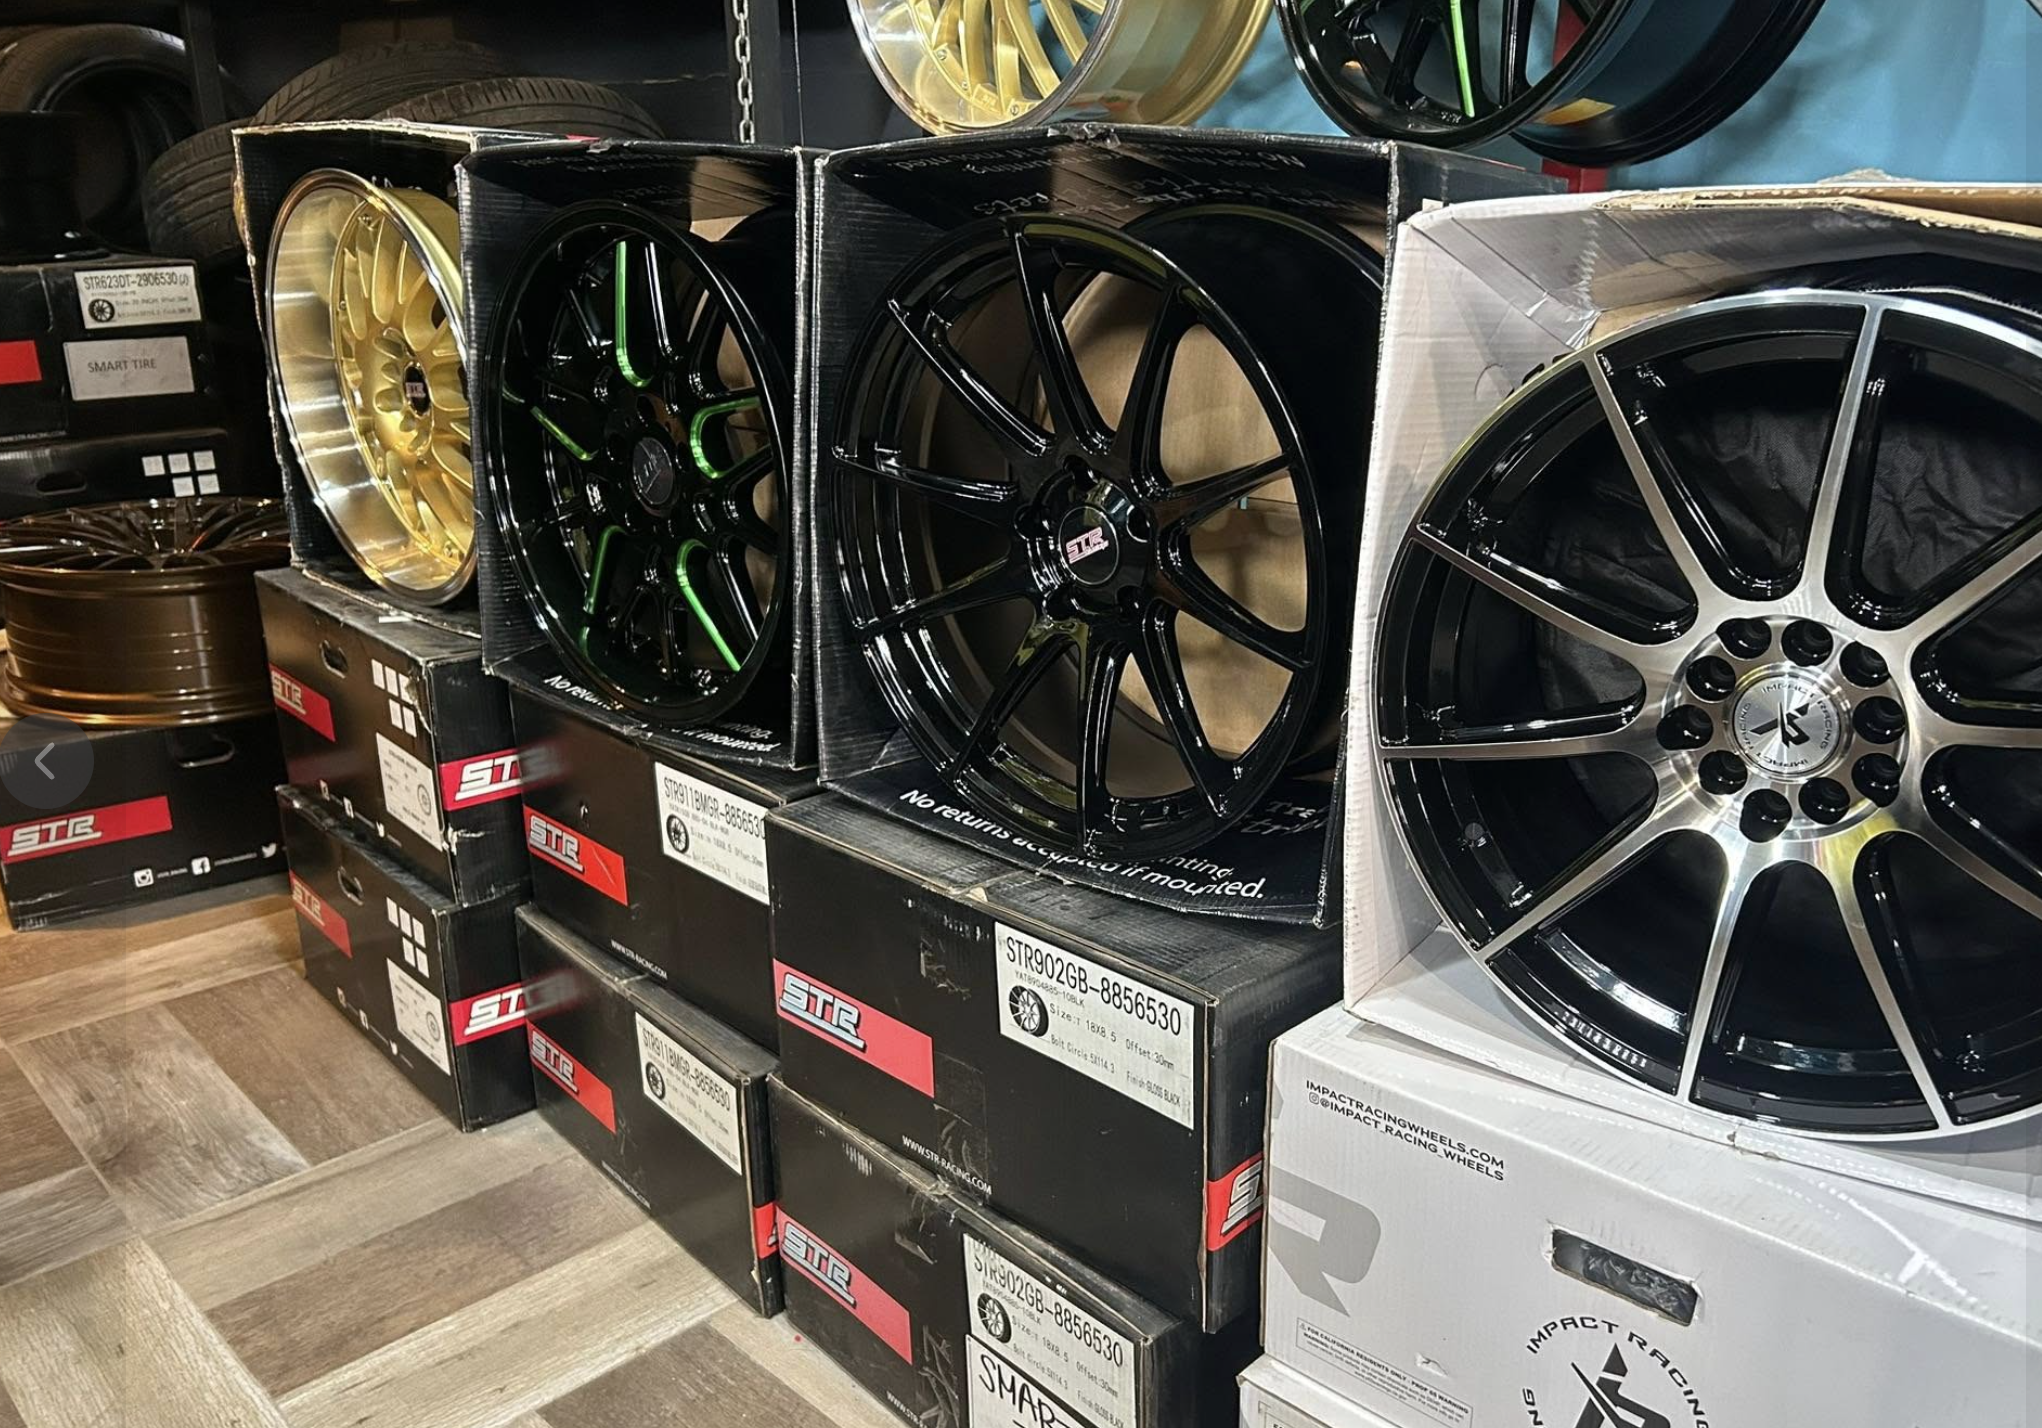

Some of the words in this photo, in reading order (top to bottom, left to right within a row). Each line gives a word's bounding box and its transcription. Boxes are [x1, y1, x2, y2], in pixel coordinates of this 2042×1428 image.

[88, 360, 128, 373] SMART
[133, 358, 158, 370] TIRE
[1066, 527, 1109, 564] STR
[7, 814, 102, 857] STR
[529, 814, 584, 872] STR
[900, 789, 936, 809] No
[933, 804, 1013, 840] returns
[1120, 861, 1151, 878] if
[1141, 871, 1266, 900] mounted.
[779, 972, 866, 1053] STR
[1005, 934, 1181, 1037] STR902GB-8856530
[531, 1030, 579, 1093] STR
[902, 1134, 992, 1195] WWW.STR-RACING.COM
[1306, 1080, 1504, 1169] IMPACTRACINGWHEELS.COM
[1320, 1097, 1504, 1181] @IMPACT_RACING_WHEELS
[781, 1222, 857, 1307] STR
[972, 1245, 1123, 1370] STR902GB-8856530
[1526, 1316, 1619, 1354] IMPACT
[1307, 1326, 1319, 1336] FOR
[1319, 1332, 1354, 1355] CALIFORNIA
[1355, 1351, 1389, 1373] RESIDENTS
[1438, 1394, 1468, 1414] WARNING
